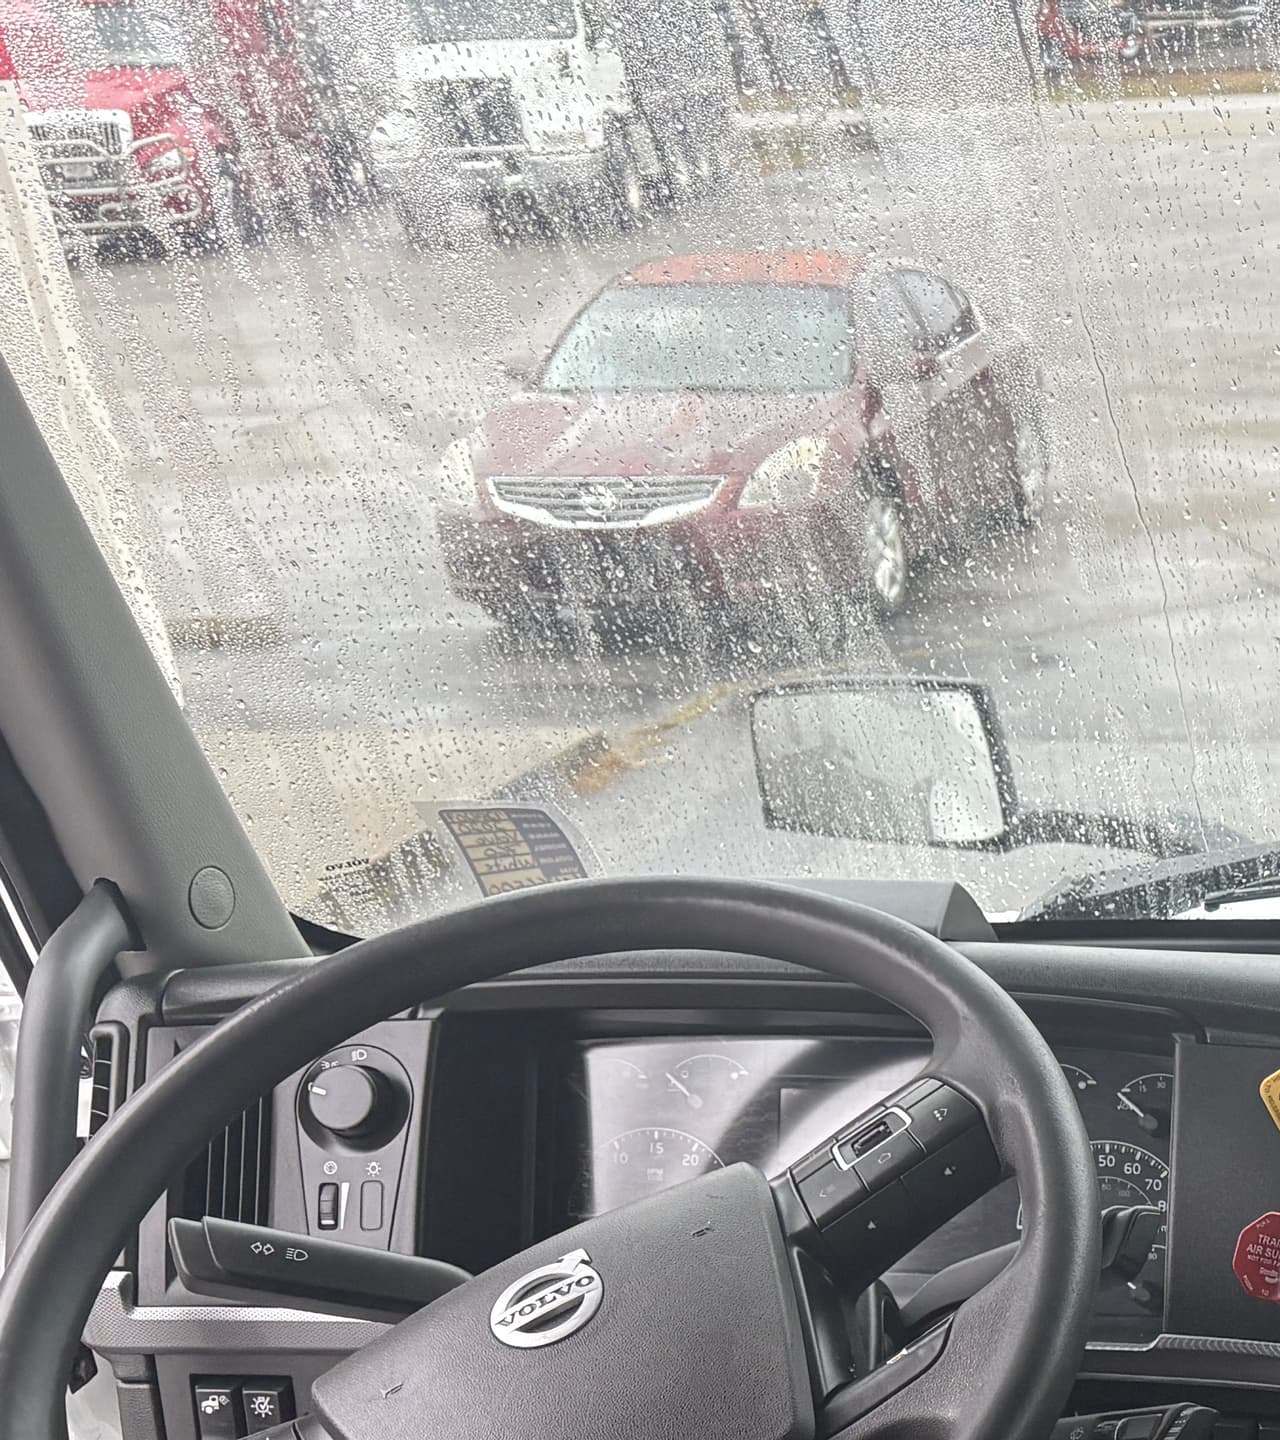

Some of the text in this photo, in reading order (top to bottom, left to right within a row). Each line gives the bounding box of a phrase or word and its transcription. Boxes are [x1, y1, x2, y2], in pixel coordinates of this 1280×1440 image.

[649, 1142, 665, 1154] 15
[682, 1153, 700, 1167] 20
[1097, 1155, 1116, 1169] 50
[1123, 1162, 1142, 1176] 60
[1145, 1178, 1163, 1192] 70
[1246, 1243, 1263, 1255] AIR
[494, 1273, 596, 1328] VOLVO
